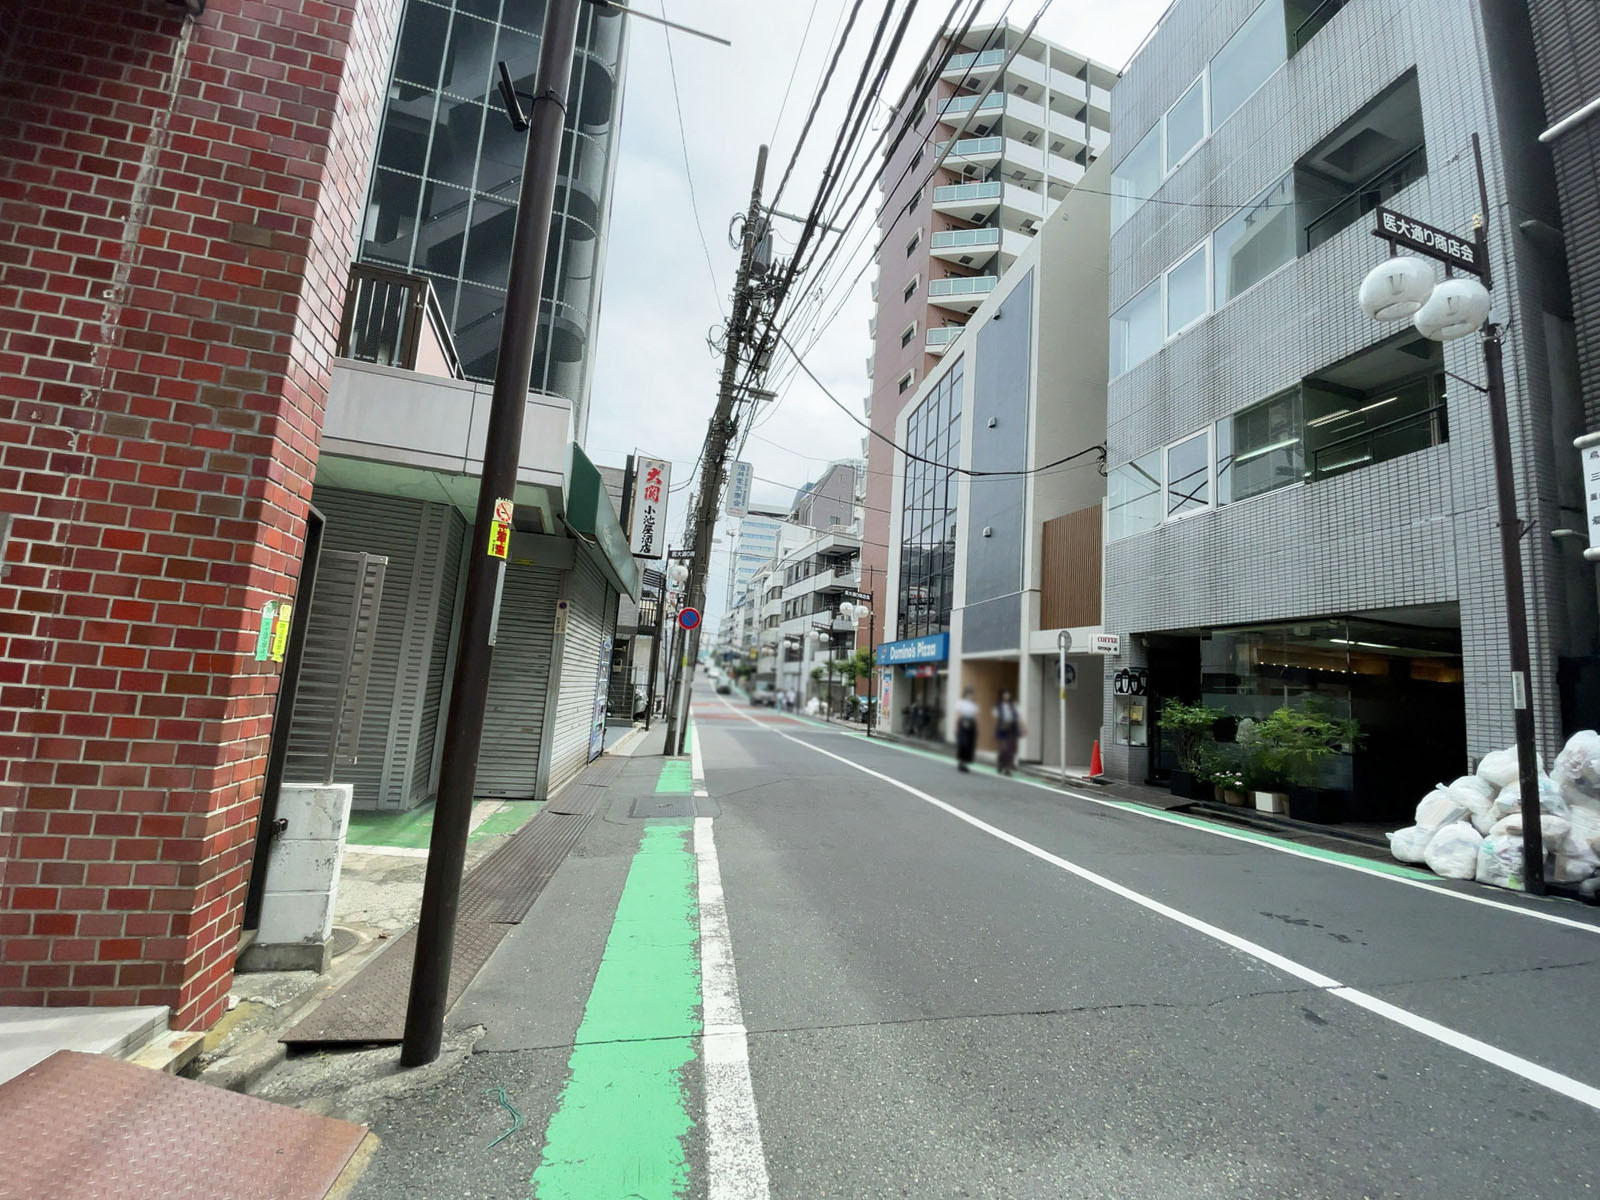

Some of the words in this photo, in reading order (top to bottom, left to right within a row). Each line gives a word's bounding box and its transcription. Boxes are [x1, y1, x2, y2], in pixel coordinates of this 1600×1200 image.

[1383, 212, 1474, 263] 医大通り商店会
[640, 505, 656, 554] 小池屋酒店
[917, 640, 937, 657] Pizza
